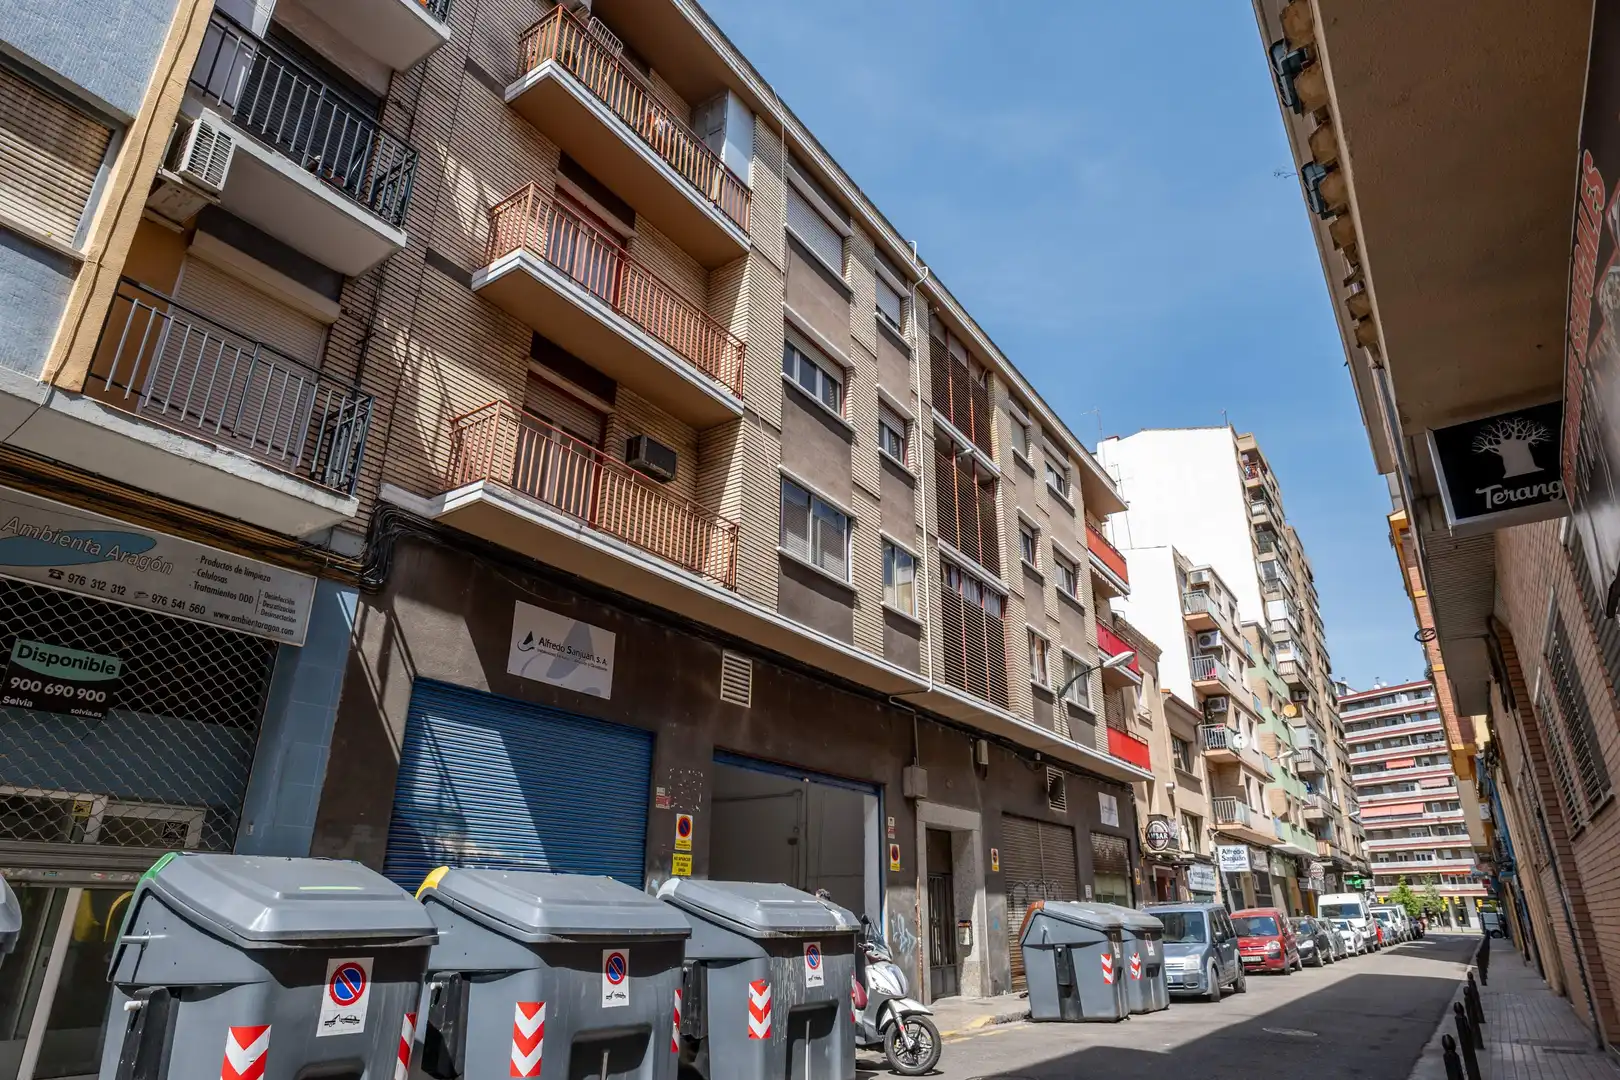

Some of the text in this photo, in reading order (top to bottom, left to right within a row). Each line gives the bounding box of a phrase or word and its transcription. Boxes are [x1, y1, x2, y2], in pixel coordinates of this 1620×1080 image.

[2, 516, 173, 575] Ambienta Aragón
[196, 568, 228, 584] Celulosas
[200, 555, 271, 582] Productos de limpieza
[68, 573, 126, 596] 976 312 312
[193, 581, 254, 604] Tratamientos DDD
[152, 594, 206, 615] 976 541 560
[538, 637, 566, 653] Alfredo
[17, 644, 116, 675] Disponible
[2, 695, 33, 708] Solvia
[10, 677, 106, 703] 900 690 900
[70, 707, 102, 718] solvia.es
